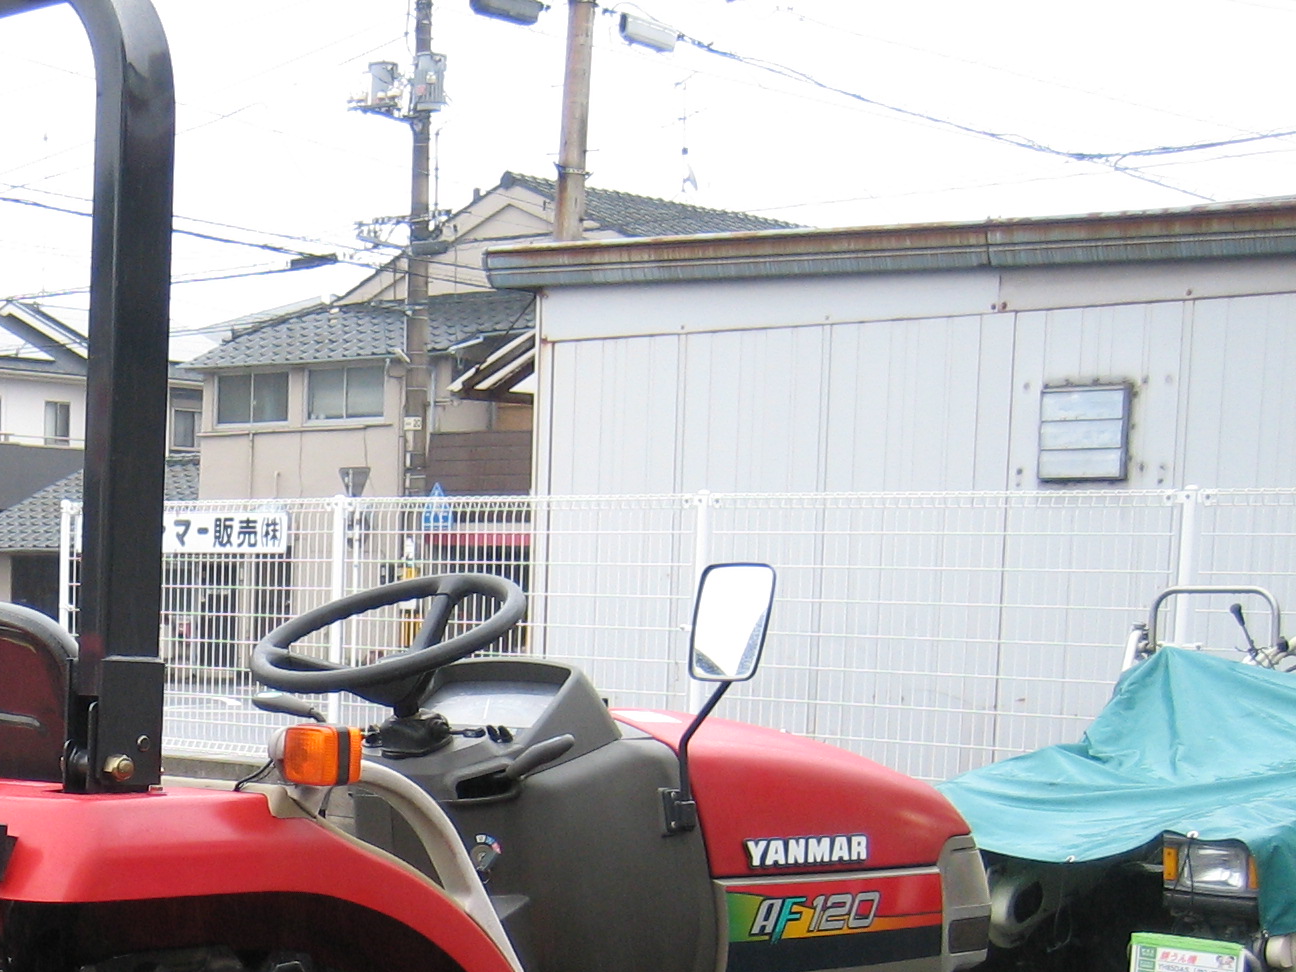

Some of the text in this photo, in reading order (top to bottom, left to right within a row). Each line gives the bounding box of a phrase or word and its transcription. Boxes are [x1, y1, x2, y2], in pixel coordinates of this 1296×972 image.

[163, 517, 283, 548] マー販売(株)
[745, 833, 869, 868] YANMAR
[750, 890, 881, 944] AF120
